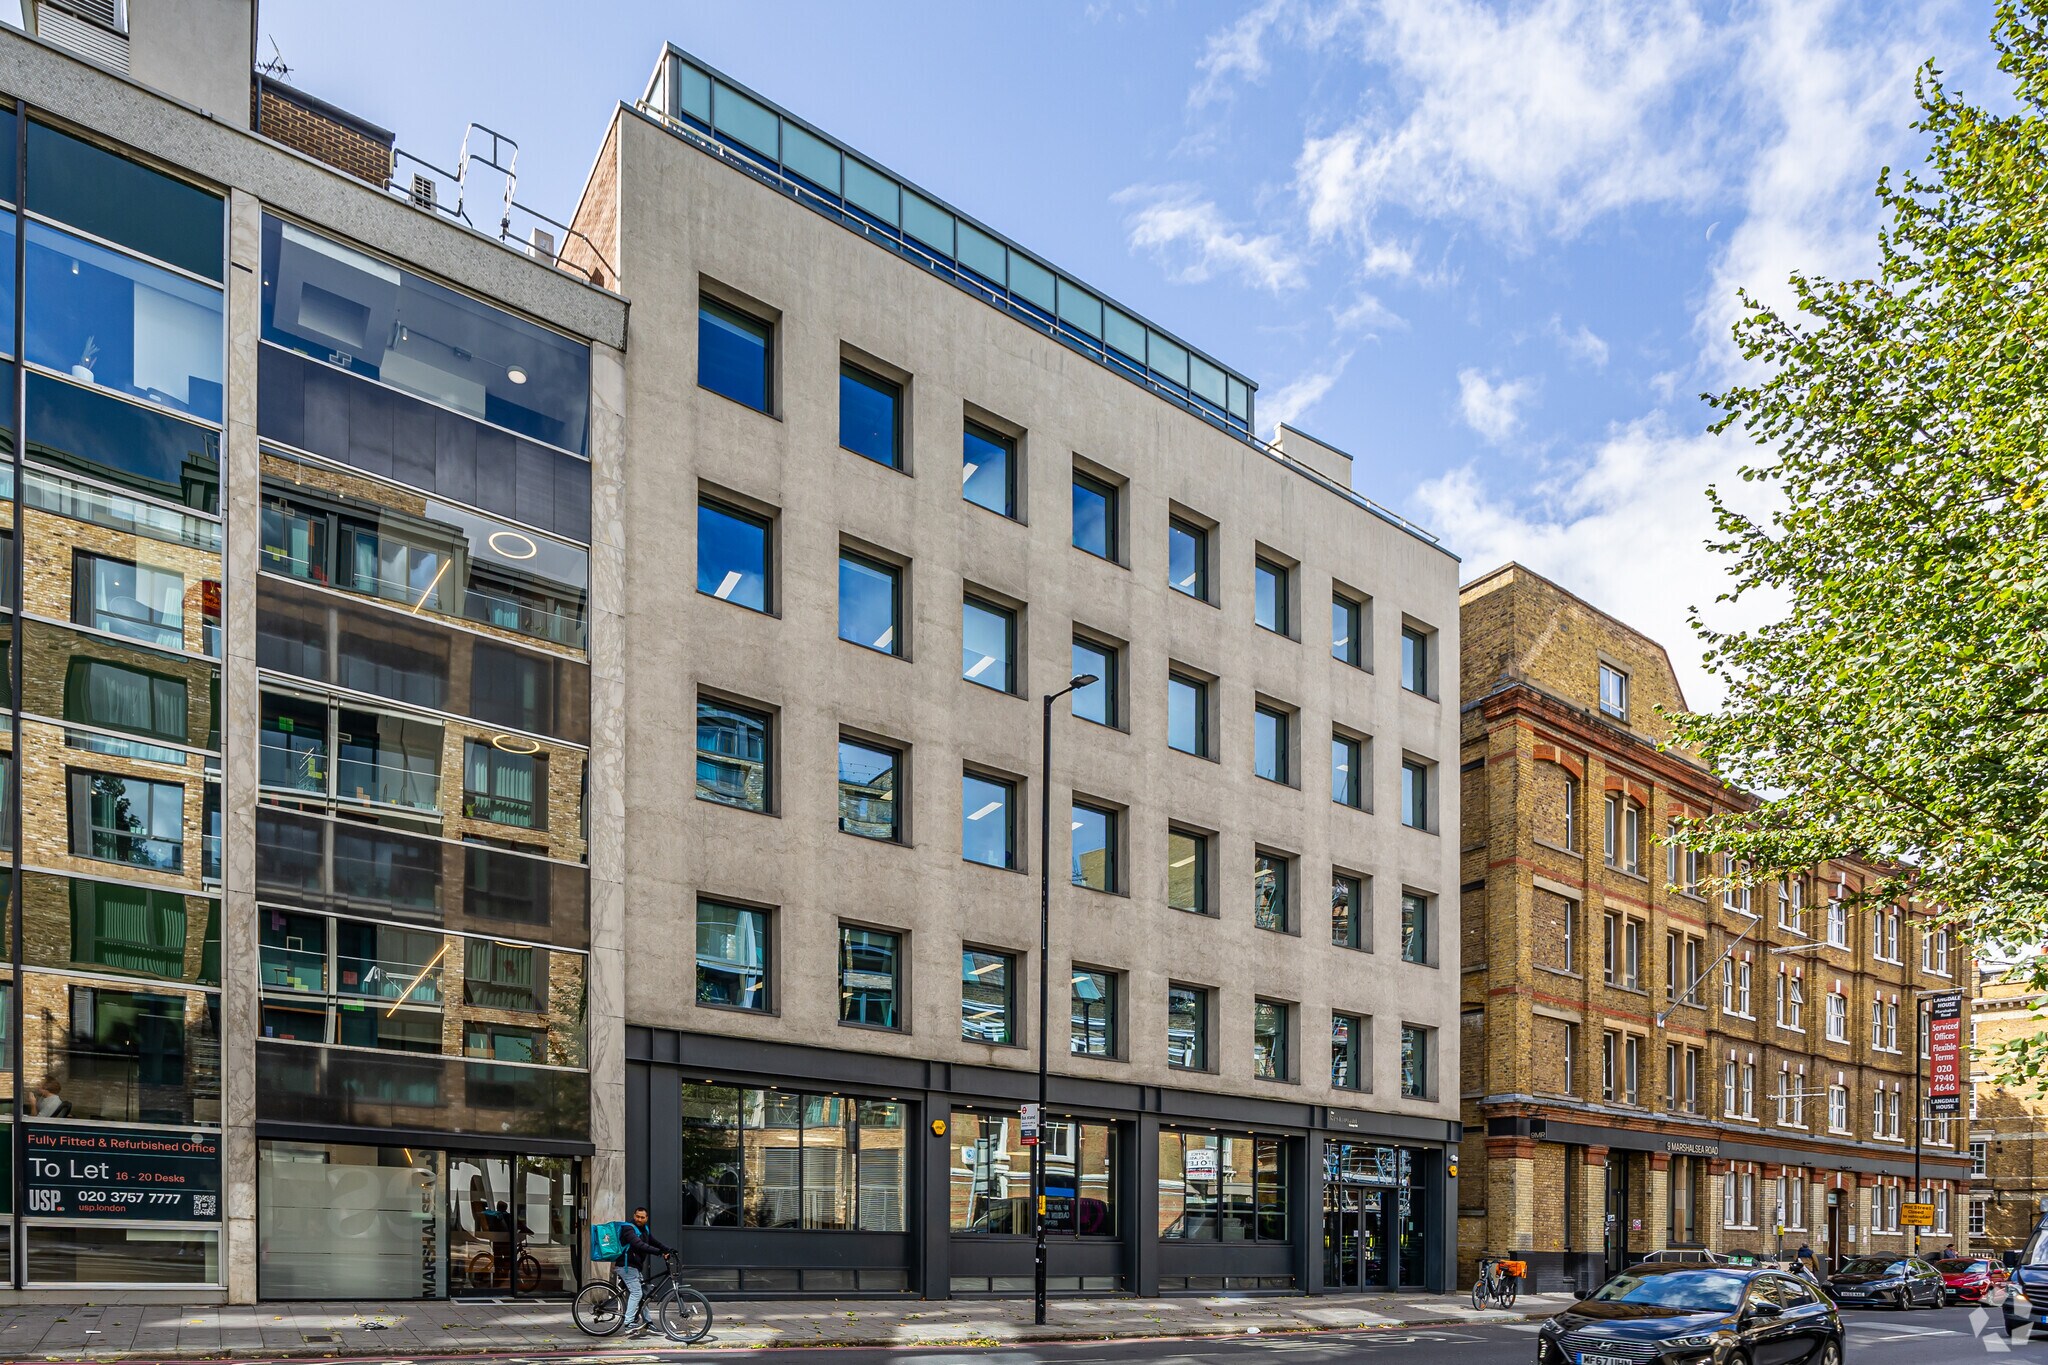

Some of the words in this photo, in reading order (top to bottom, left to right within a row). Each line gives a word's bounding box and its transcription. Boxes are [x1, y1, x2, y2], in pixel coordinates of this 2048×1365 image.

[1933, 995, 1961, 1003] LANGDALE
[1932, 1022, 1959, 1032] Serviced
[1934, 1032, 1955, 1040] Offices
[1933, 1043, 1956, 1052] Flexible
[1935, 1053, 1954, 1061] Terms
[1530, 1131, 1546, 1139] 9MR
[28, 1134, 57, 1147] Fully
[60, 1136, 95, 1147] Fitted
[98, 1138, 107, 1148] &
[110, 1139, 179, 1151] Refurbished
[182, 1142, 216, 1153] Office
[1666, 1142, 1671, 1150] 9
[1671, 1142, 1704, 1153] MARSHALSEA
[1705, 1146, 1719, 1155] ROAD
[28, 1157, 61, 1178] To
[70, 1159, 109, 1179] Let
[115, 1172, 128, 1181] 16
[138, 1172, 152, 1182] 20
[154, 1173, 185, 1183] Desks
[78, 1191, 106, 1202] 020
[110, 1192, 144, 1203] 3757
[148, 1193, 181, 1205] 7777
[78, 1204, 126, 1213] usp.london
[1583, 1354, 1609, 1365] MF67
